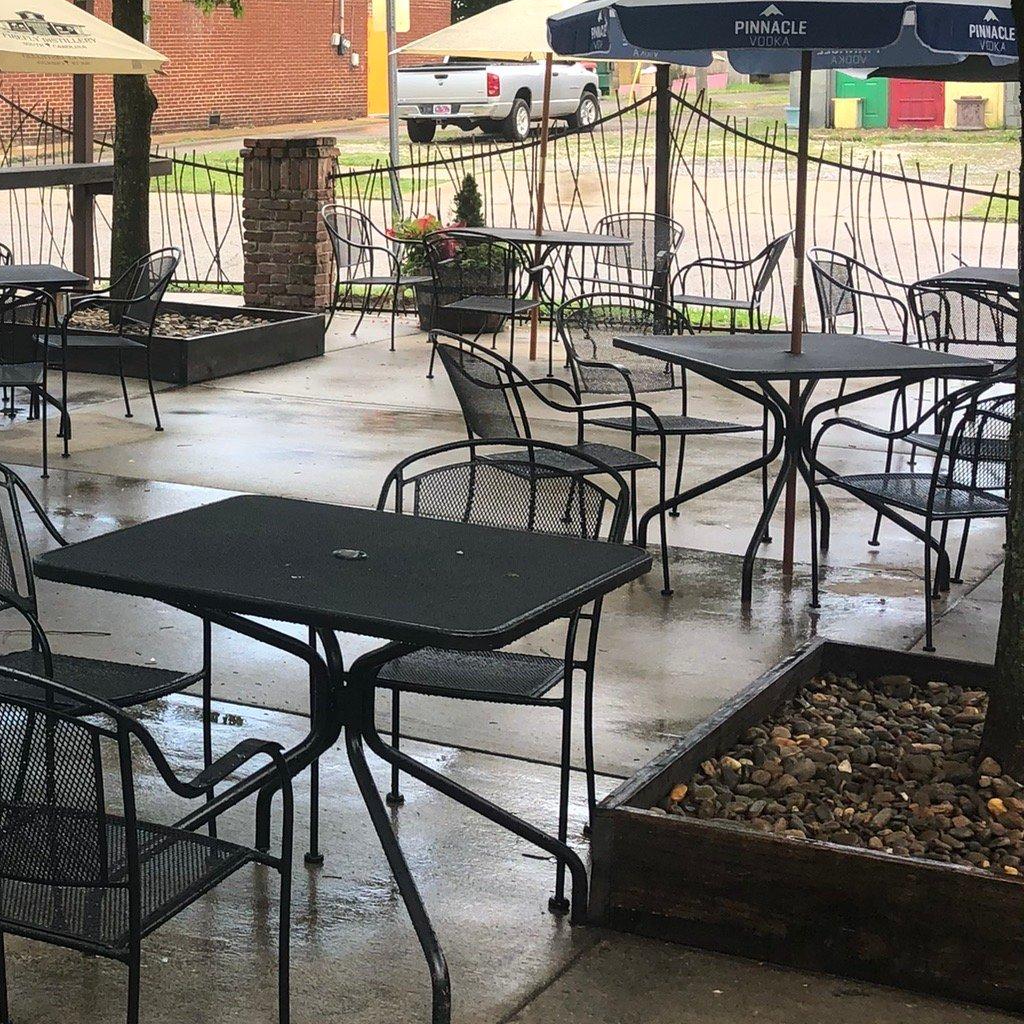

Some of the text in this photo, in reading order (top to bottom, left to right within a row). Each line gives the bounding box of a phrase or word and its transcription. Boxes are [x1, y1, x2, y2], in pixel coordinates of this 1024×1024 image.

[734, 20, 807, 35] PINNACLE
[969, 24, 1016, 41] PINNACLE
[749, 36, 790, 47] VODKA
